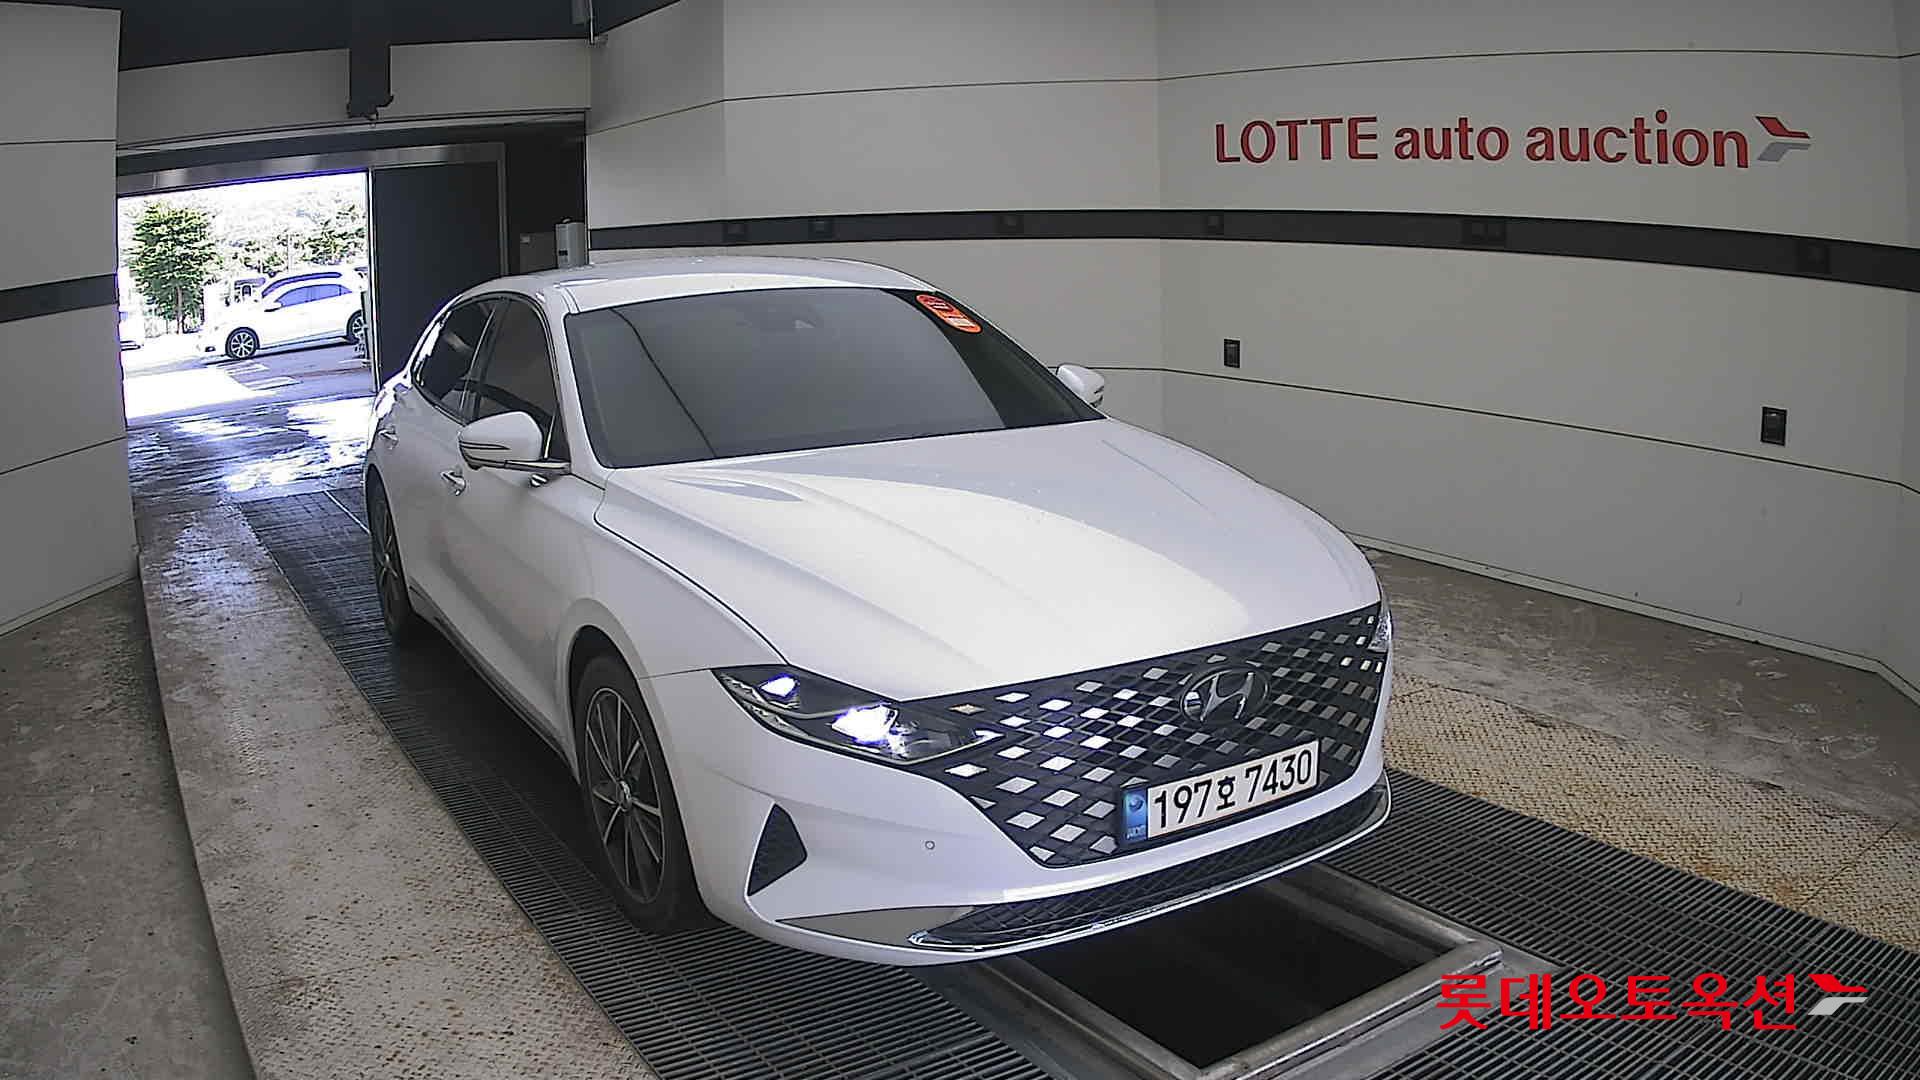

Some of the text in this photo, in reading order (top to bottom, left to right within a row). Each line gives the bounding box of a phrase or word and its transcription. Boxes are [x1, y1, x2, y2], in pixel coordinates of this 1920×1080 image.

[1216, 110, 1750, 169] LOTTE auto auction
[1154, 749, 1313, 829] 197호 7430
